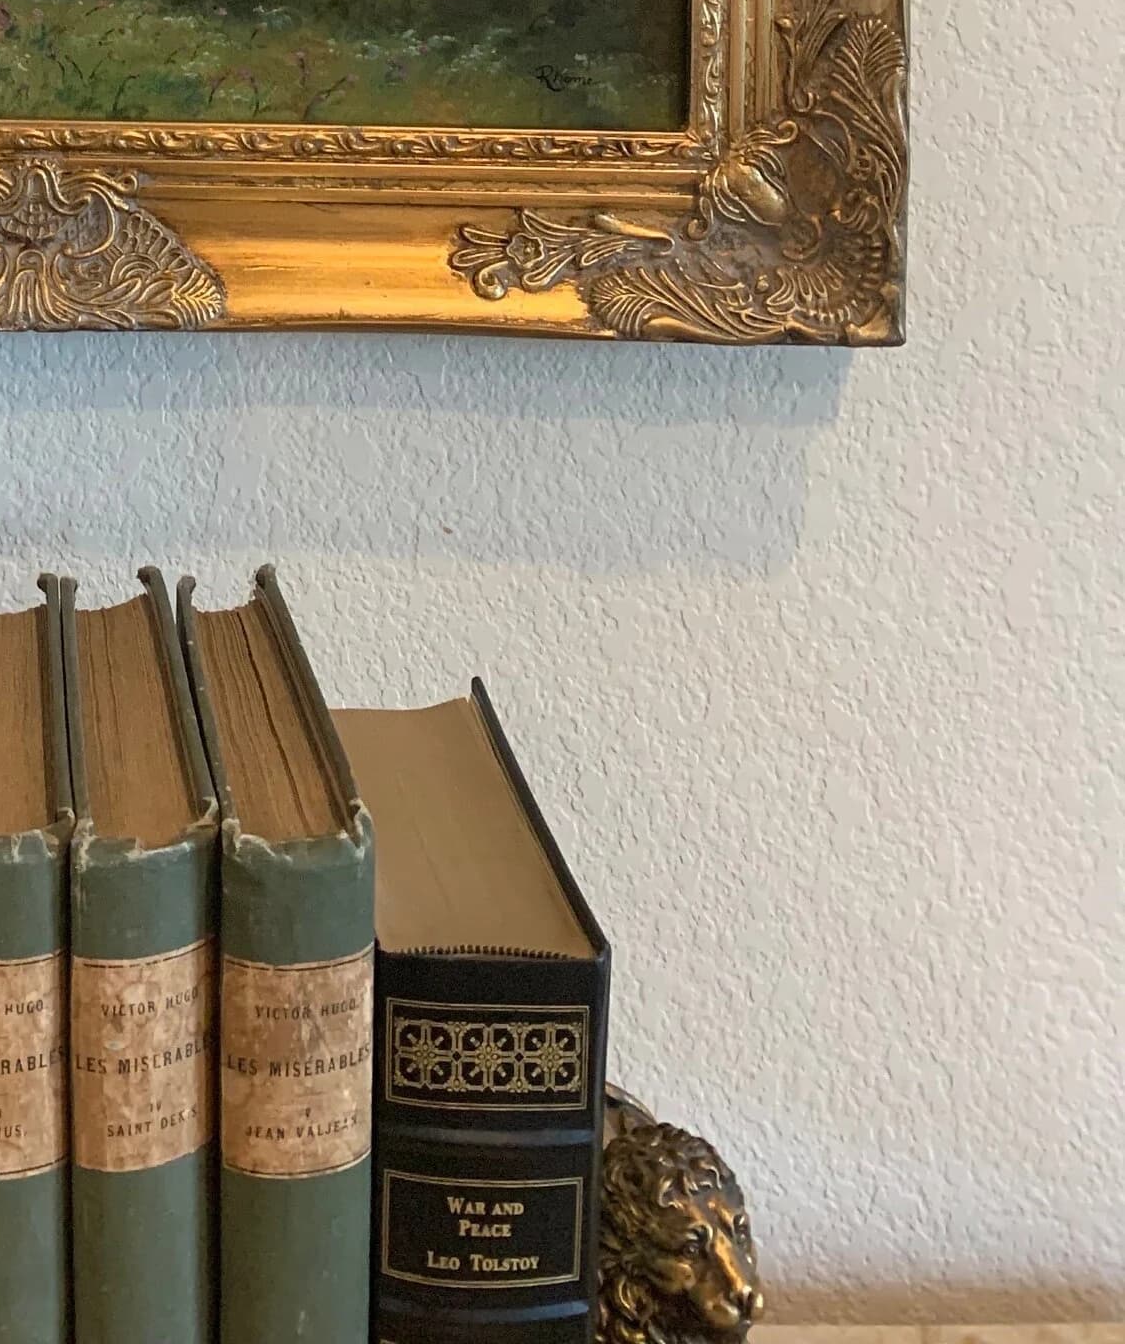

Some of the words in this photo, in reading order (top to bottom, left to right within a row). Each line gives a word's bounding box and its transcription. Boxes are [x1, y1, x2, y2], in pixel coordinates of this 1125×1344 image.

[5, 998, 44, 1016] HUGO
[101, 1002, 156, 1018] VICTOR
[165, 986, 199, 1009] HUGO
[254, 1004, 310, 1021] VICTOR
[320, 998, 357, 1017] HUGO
[76, 1053, 107, 1075] LES
[227, 1053, 258, 1076] LES
[107, 1119, 153, 1138] SAINT
[160, 1108, 197, 1130] DENS
[245, 1125, 285, 1141] JEAN
